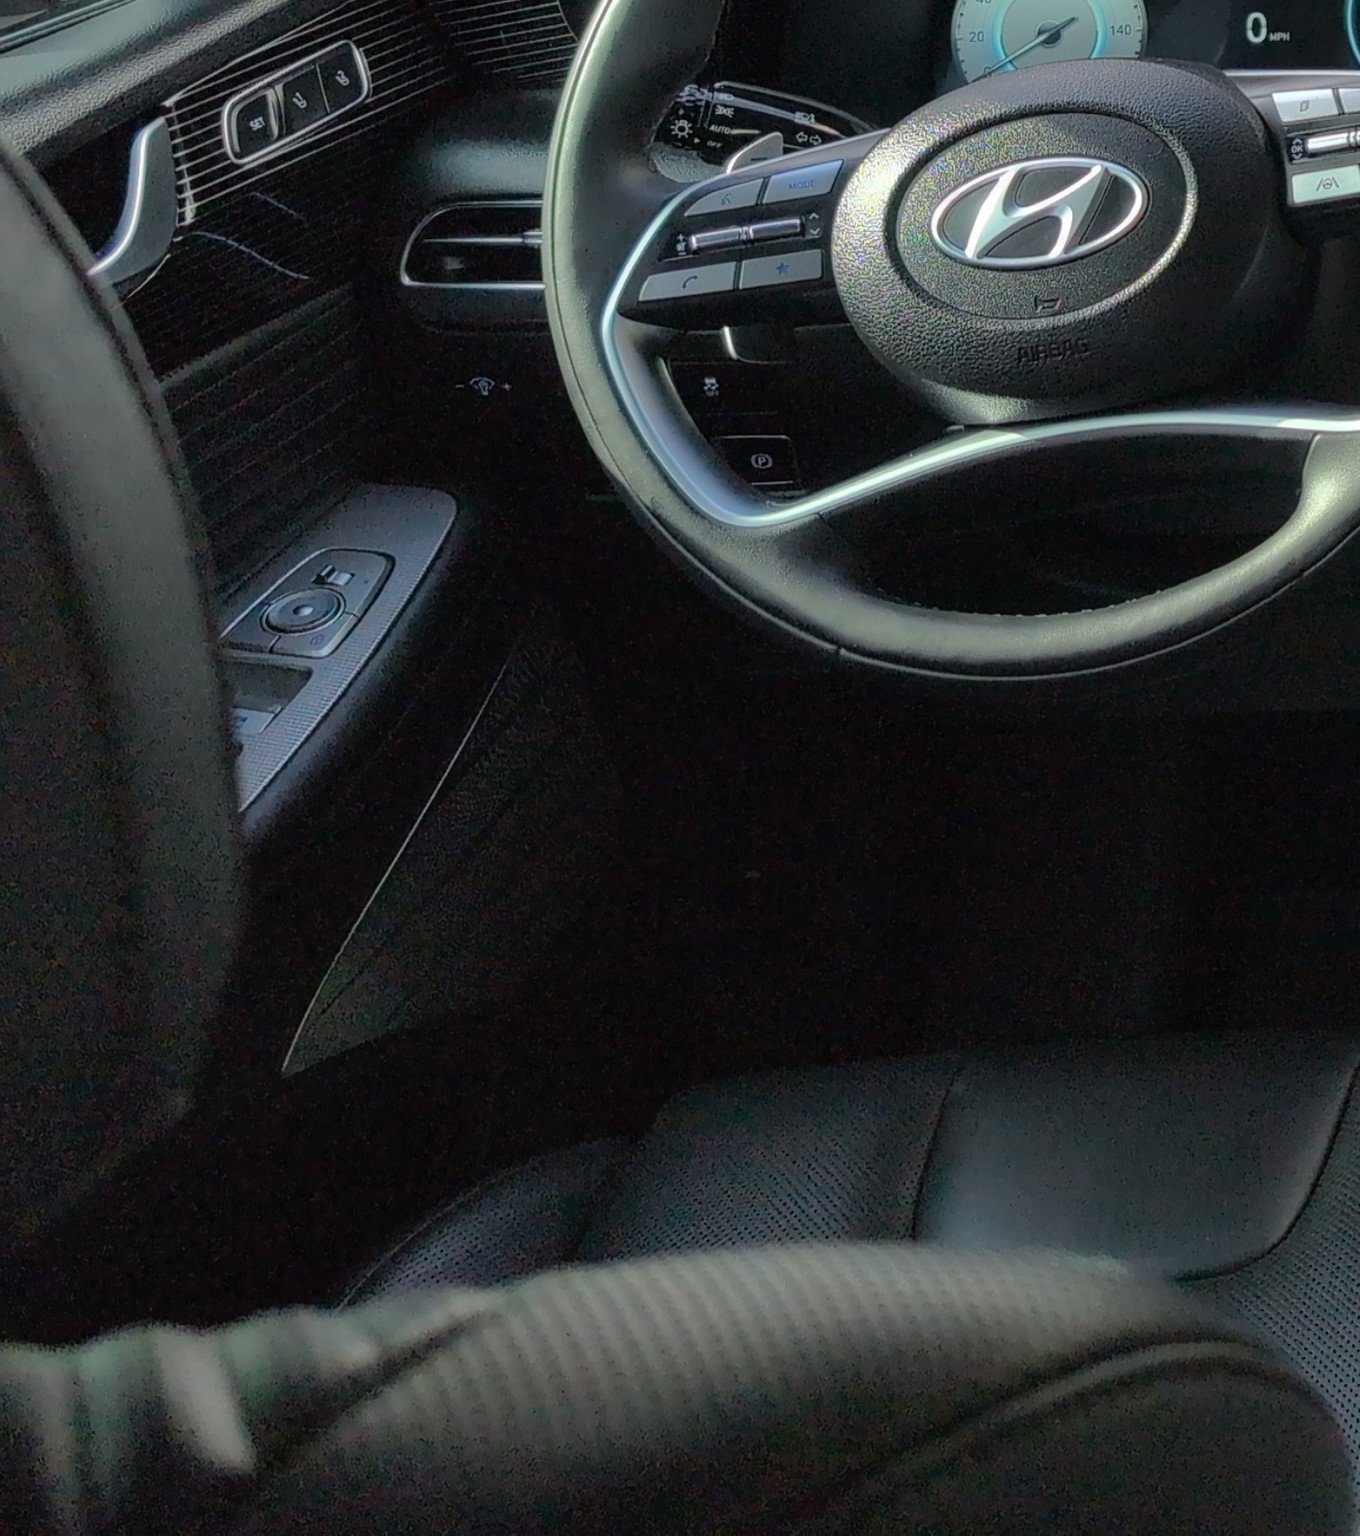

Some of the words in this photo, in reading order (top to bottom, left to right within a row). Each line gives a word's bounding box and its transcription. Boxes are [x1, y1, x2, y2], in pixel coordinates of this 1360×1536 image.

[1110, 24, 1132, 36] 140
[1245, 12, 1267, 44] 0
[1270, 31, 1291, 42] MPH
[969, 31, 985, 43] 20
[709, 124, 731, 135] AUTO
